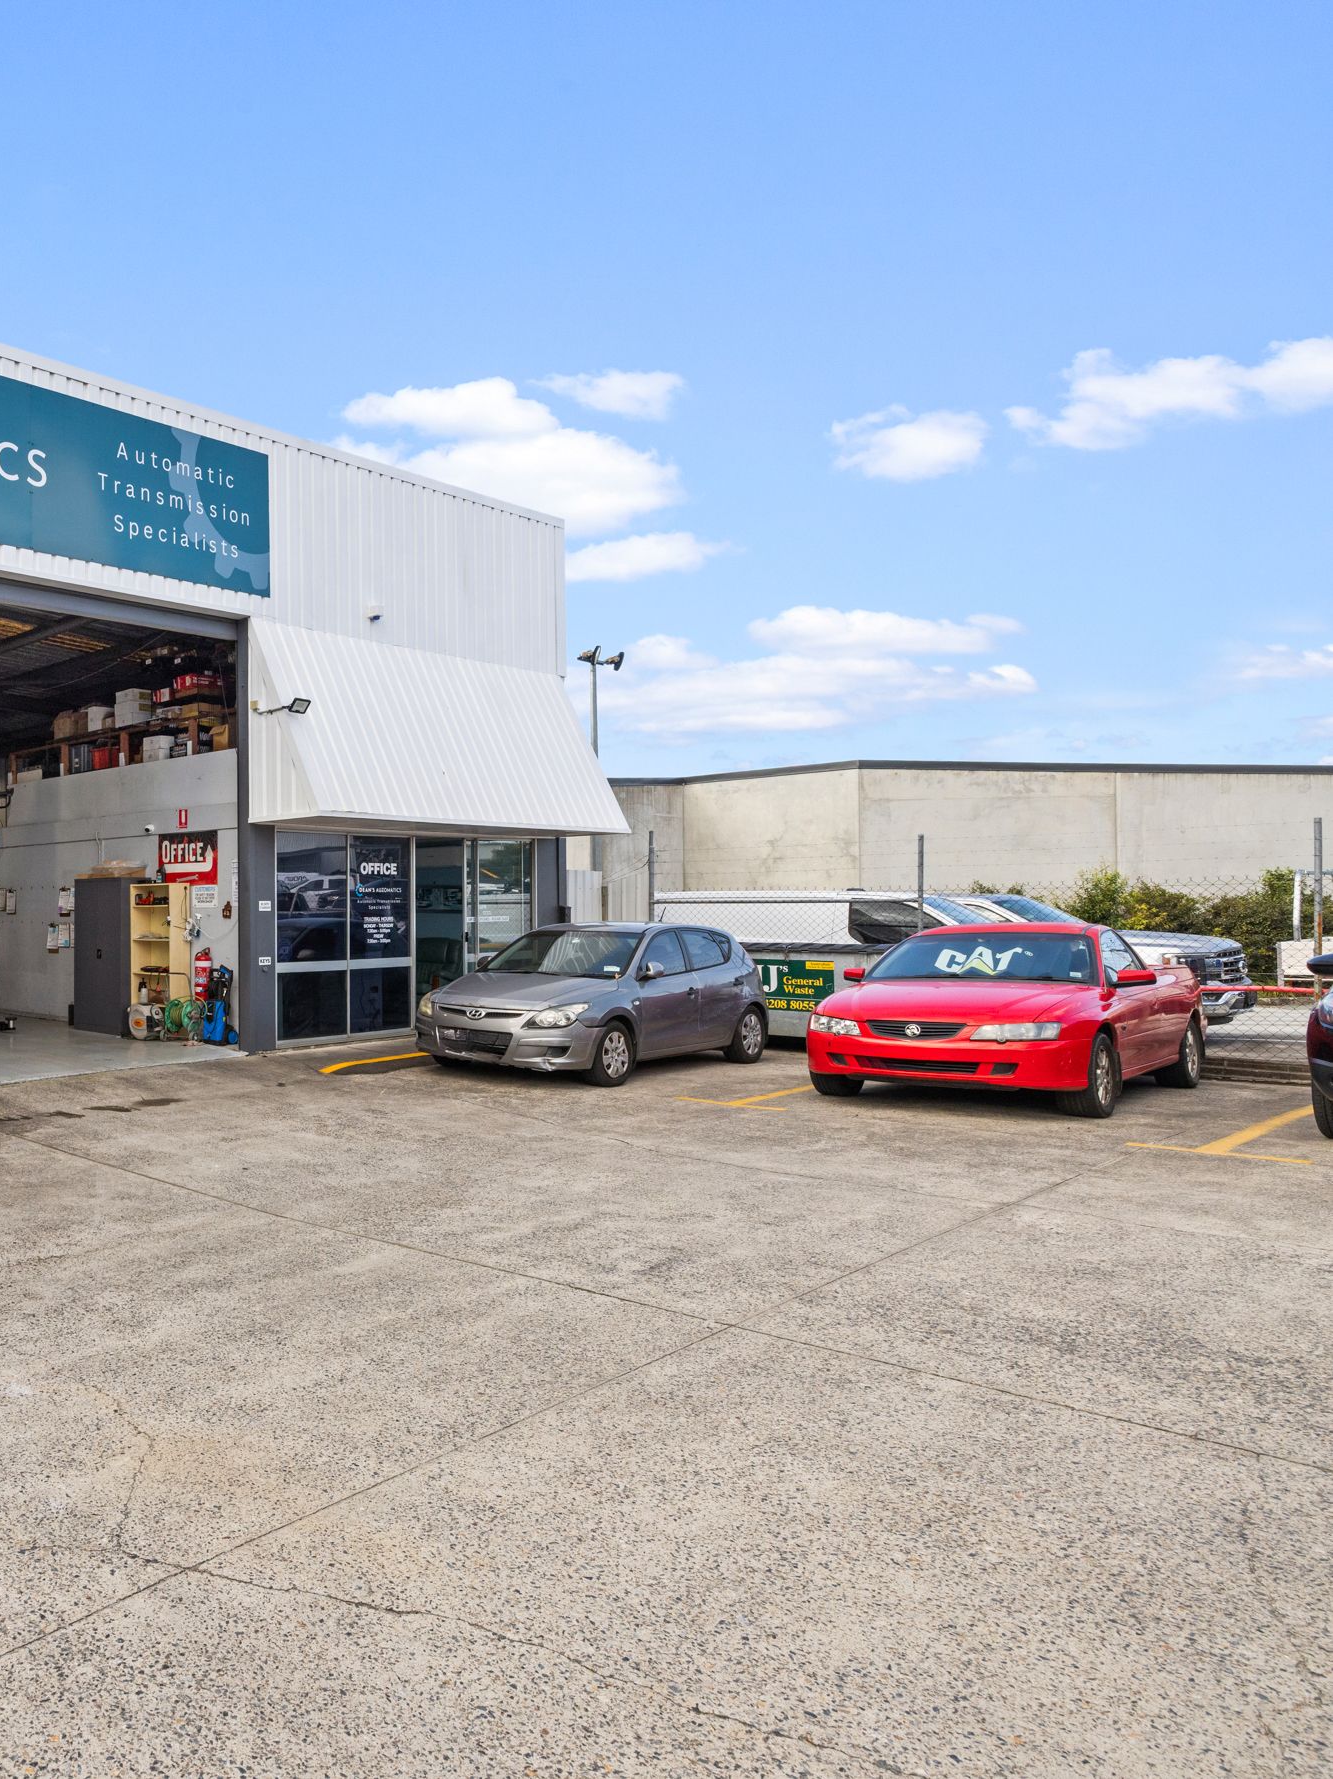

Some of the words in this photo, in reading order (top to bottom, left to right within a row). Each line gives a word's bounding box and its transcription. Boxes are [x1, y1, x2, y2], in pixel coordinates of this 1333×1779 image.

[116, 442, 235, 489] Automatic
[97, 472, 250, 526] Transmission
[114, 514, 239, 558] Specialists
[161, 840, 204, 863] OFFICE
[360, 862, 398, 875] OFFICE
[934, 945, 1023, 976] CAT
[783, 975, 824, 987] General
[783, 985, 815, 995] Waste
[789, 1000, 816, 1011] 8055
